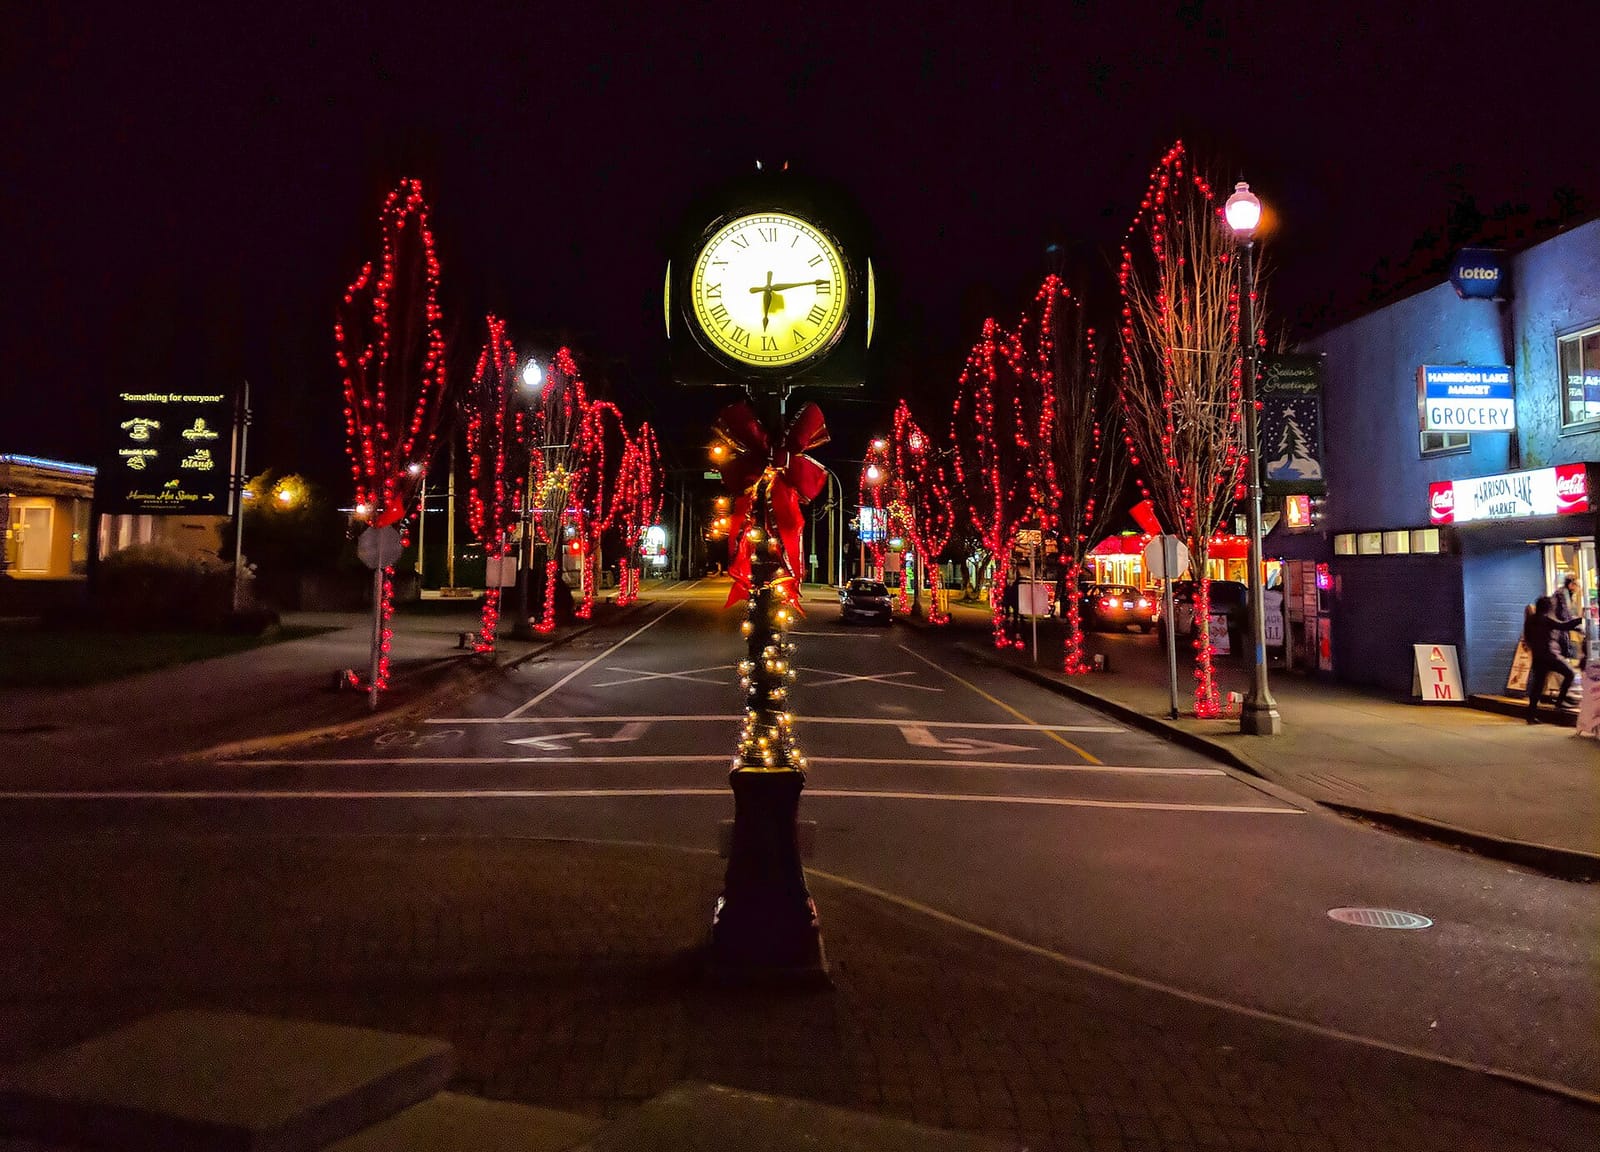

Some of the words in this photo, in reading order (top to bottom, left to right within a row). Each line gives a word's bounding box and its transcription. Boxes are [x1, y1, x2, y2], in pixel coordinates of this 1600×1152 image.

[807, 254, 824, 267] II
[706, 283, 722, 299] IX
[709, 303, 732, 332] VIII
[729, 325, 751, 348] VII
[761, 336, 779, 351] VI
[792, 329, 807, 345] V
[1428, 373, 1481, 382] HARRISON
[1483, 373, 1509, 383] LAKE
[169, 393, 182, 401] for
[1448, 385, 1490, 395] MARKET
[1432, 407, 1509, 425] GROCERY
[1473, 478, 1511, 511] HARRISON
[1512, 475, 1533, 507] LAKE
[1488, 501, 1517, 515] MARKET
[1430, 646, 1452, 700] ATM
